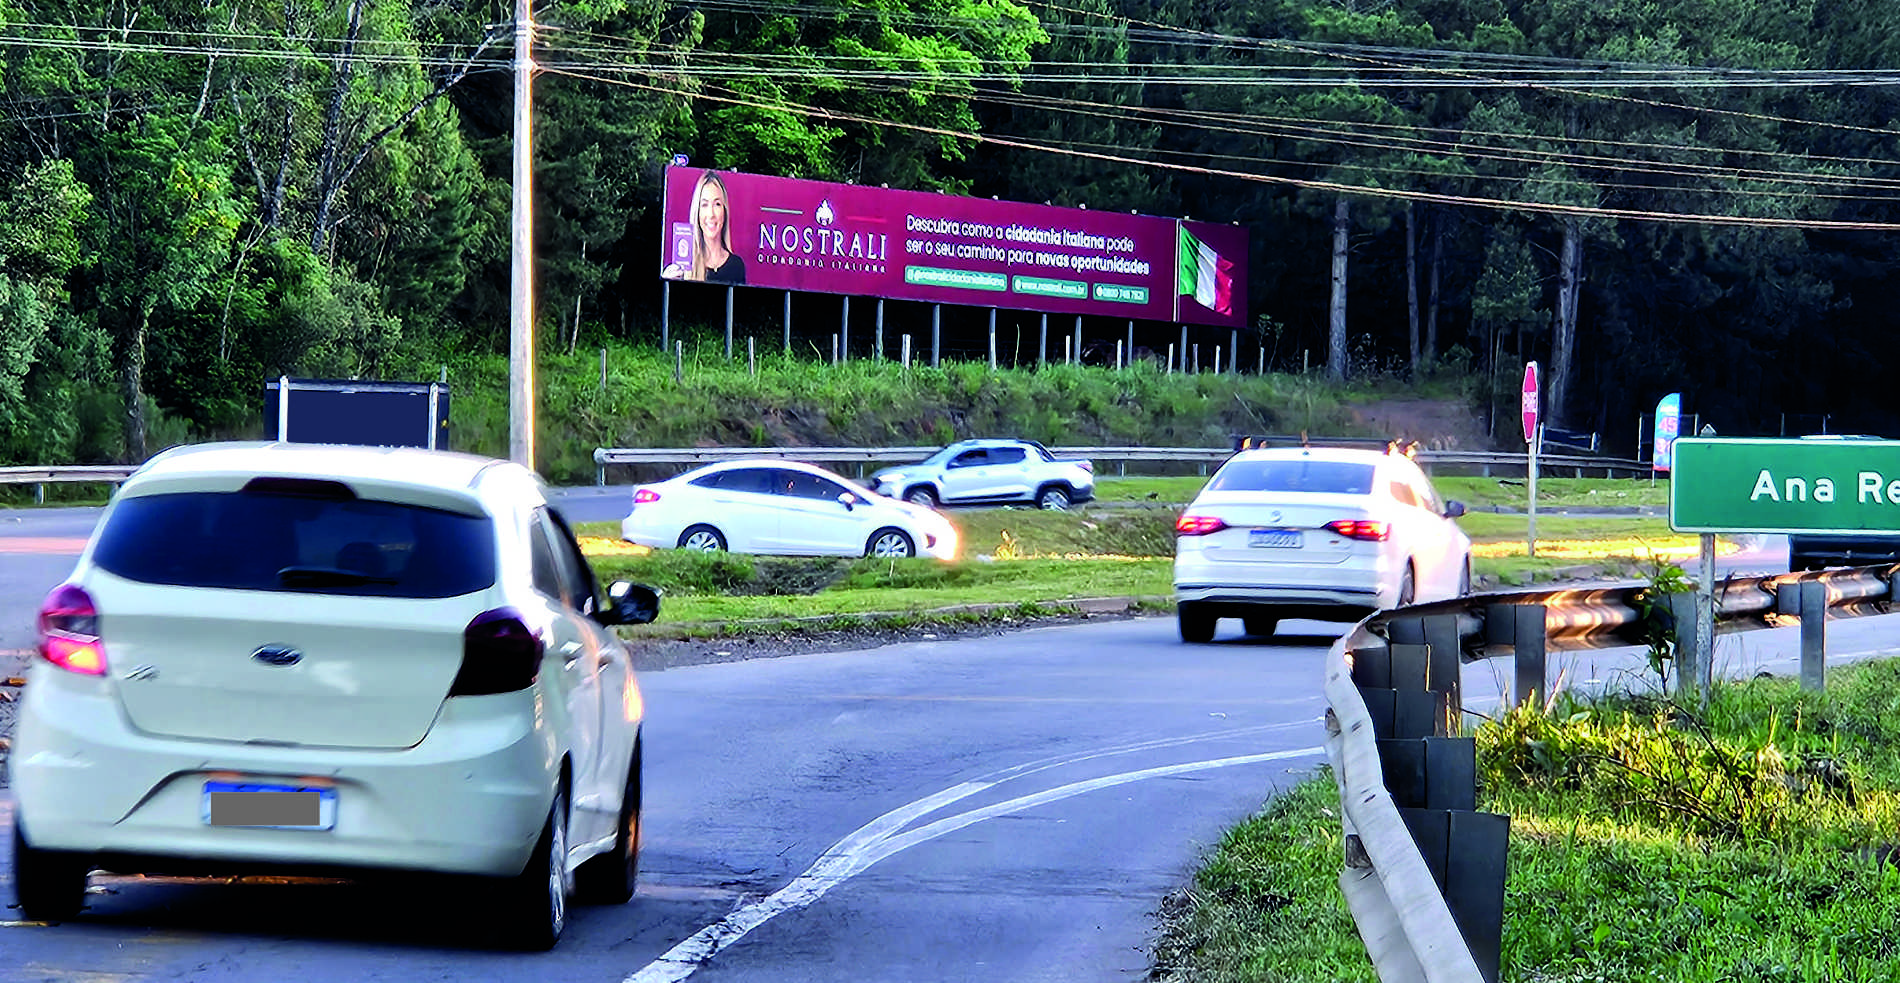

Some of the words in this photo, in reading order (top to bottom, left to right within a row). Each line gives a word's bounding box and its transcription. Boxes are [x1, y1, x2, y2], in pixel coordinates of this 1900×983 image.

[760, 223, 887, 260] NOSTRALI
[906, 214, 960, 236] Descubra
[961, 222, 994, 239] como
[995, 226, 1004, 240] a
[1005, 223, 1062, 245] cidadania
[1062, 228, 1105, 250] italiana
[1106, 237, 1135, 254] pode
[758, 253, 824, 268] CIDADANIA
[832, 261, 886, 273] ITALIANA
[905, 239, 923, 254] ser
[925, 240, 934, 255] o
[935, 242, 956, 257] seu
[957, 243, 1006, 262] caminho
[1007, 249, 1034, 266] para
[1035, 250, 1070, 268] novas
[1070, 254, 1150, 275] oportunidades
[1750, 469, 1835, 503] Ana
[1858, 471, 1900, 505] Re
